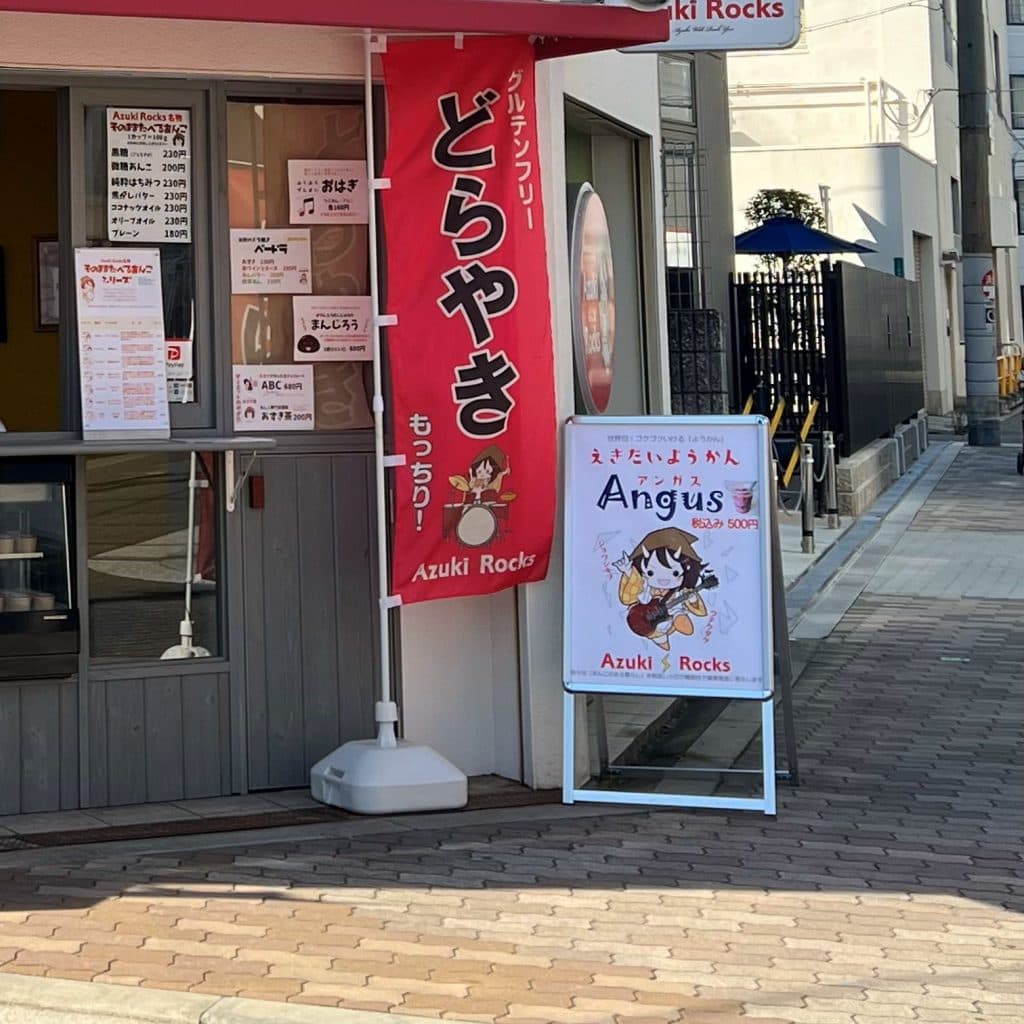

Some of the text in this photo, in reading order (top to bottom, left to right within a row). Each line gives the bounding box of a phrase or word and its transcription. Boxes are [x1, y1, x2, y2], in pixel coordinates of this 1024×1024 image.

[113, 111, 138, 121] Azuki
[140, 111, 166, 122] Rocks
[507, 69, 534, 230] グルテンフリー
[163, 178, 187, 188] 230円
[321, 178, 359, 194] おはぎ
[164, 192, 188, 201] 230円
[164, 203, 188, 213] 230円
[164, 216, 188, 226] 230円
[432, 87, 519, 439] どらやき
[311, 319, 359, 331] まんじろう
[261, 380, 282, 391] ABC
[591, 448, 740, 465] えきたいようかん
[409, 413, 433, 531] もっちり!
[637, 475, 702, 486] アンガス
[597, 474, 724, 521] Angus
[691, 517, 759, 530] 税込み 500円
[411, 552, 537, 583] Azuki Rocks
[600, 652, 731, 672] Azuki Rocks
